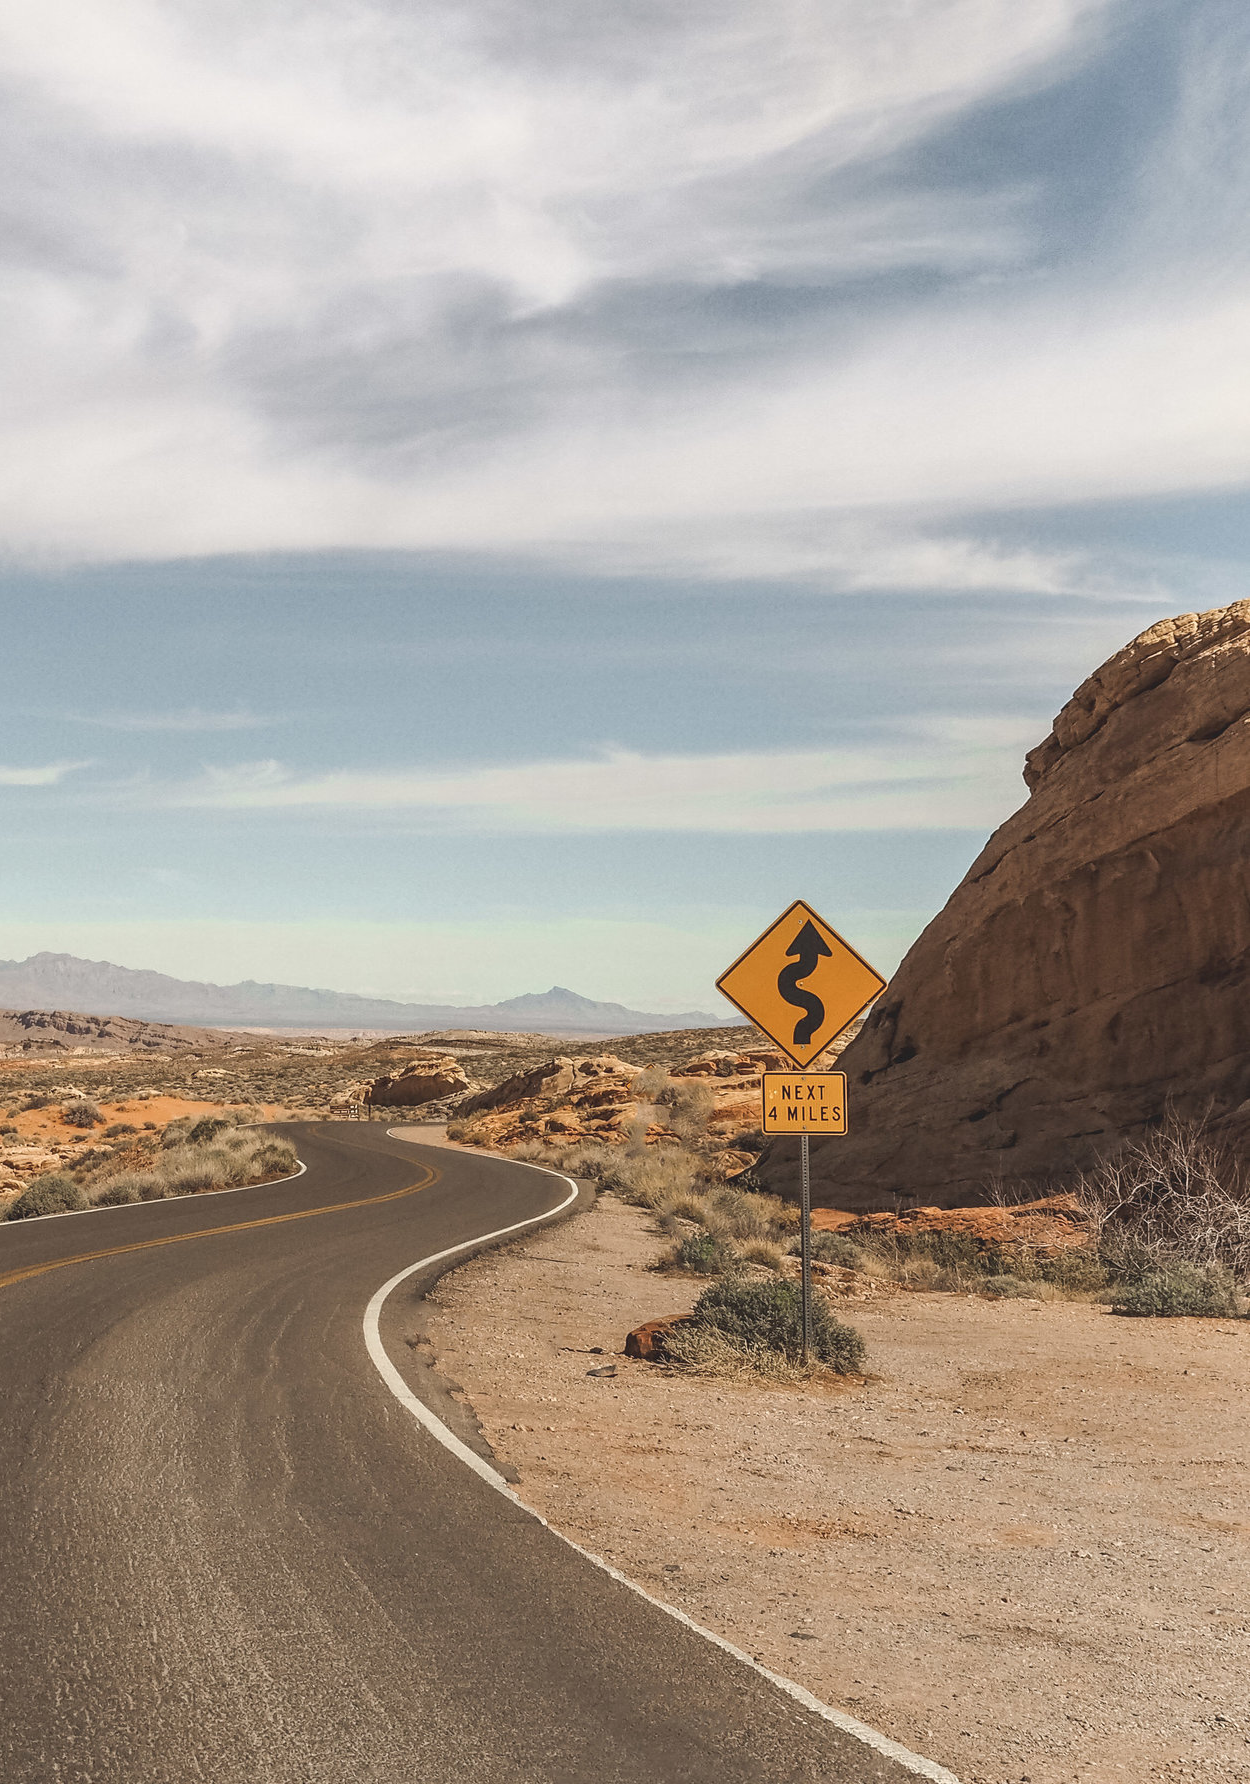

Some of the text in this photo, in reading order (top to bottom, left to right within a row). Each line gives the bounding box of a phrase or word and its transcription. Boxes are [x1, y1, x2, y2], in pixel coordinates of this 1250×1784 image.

[782, 1085, 825, 1100] NEXT
[768, 1106, 841, 1121] 4 MILES
